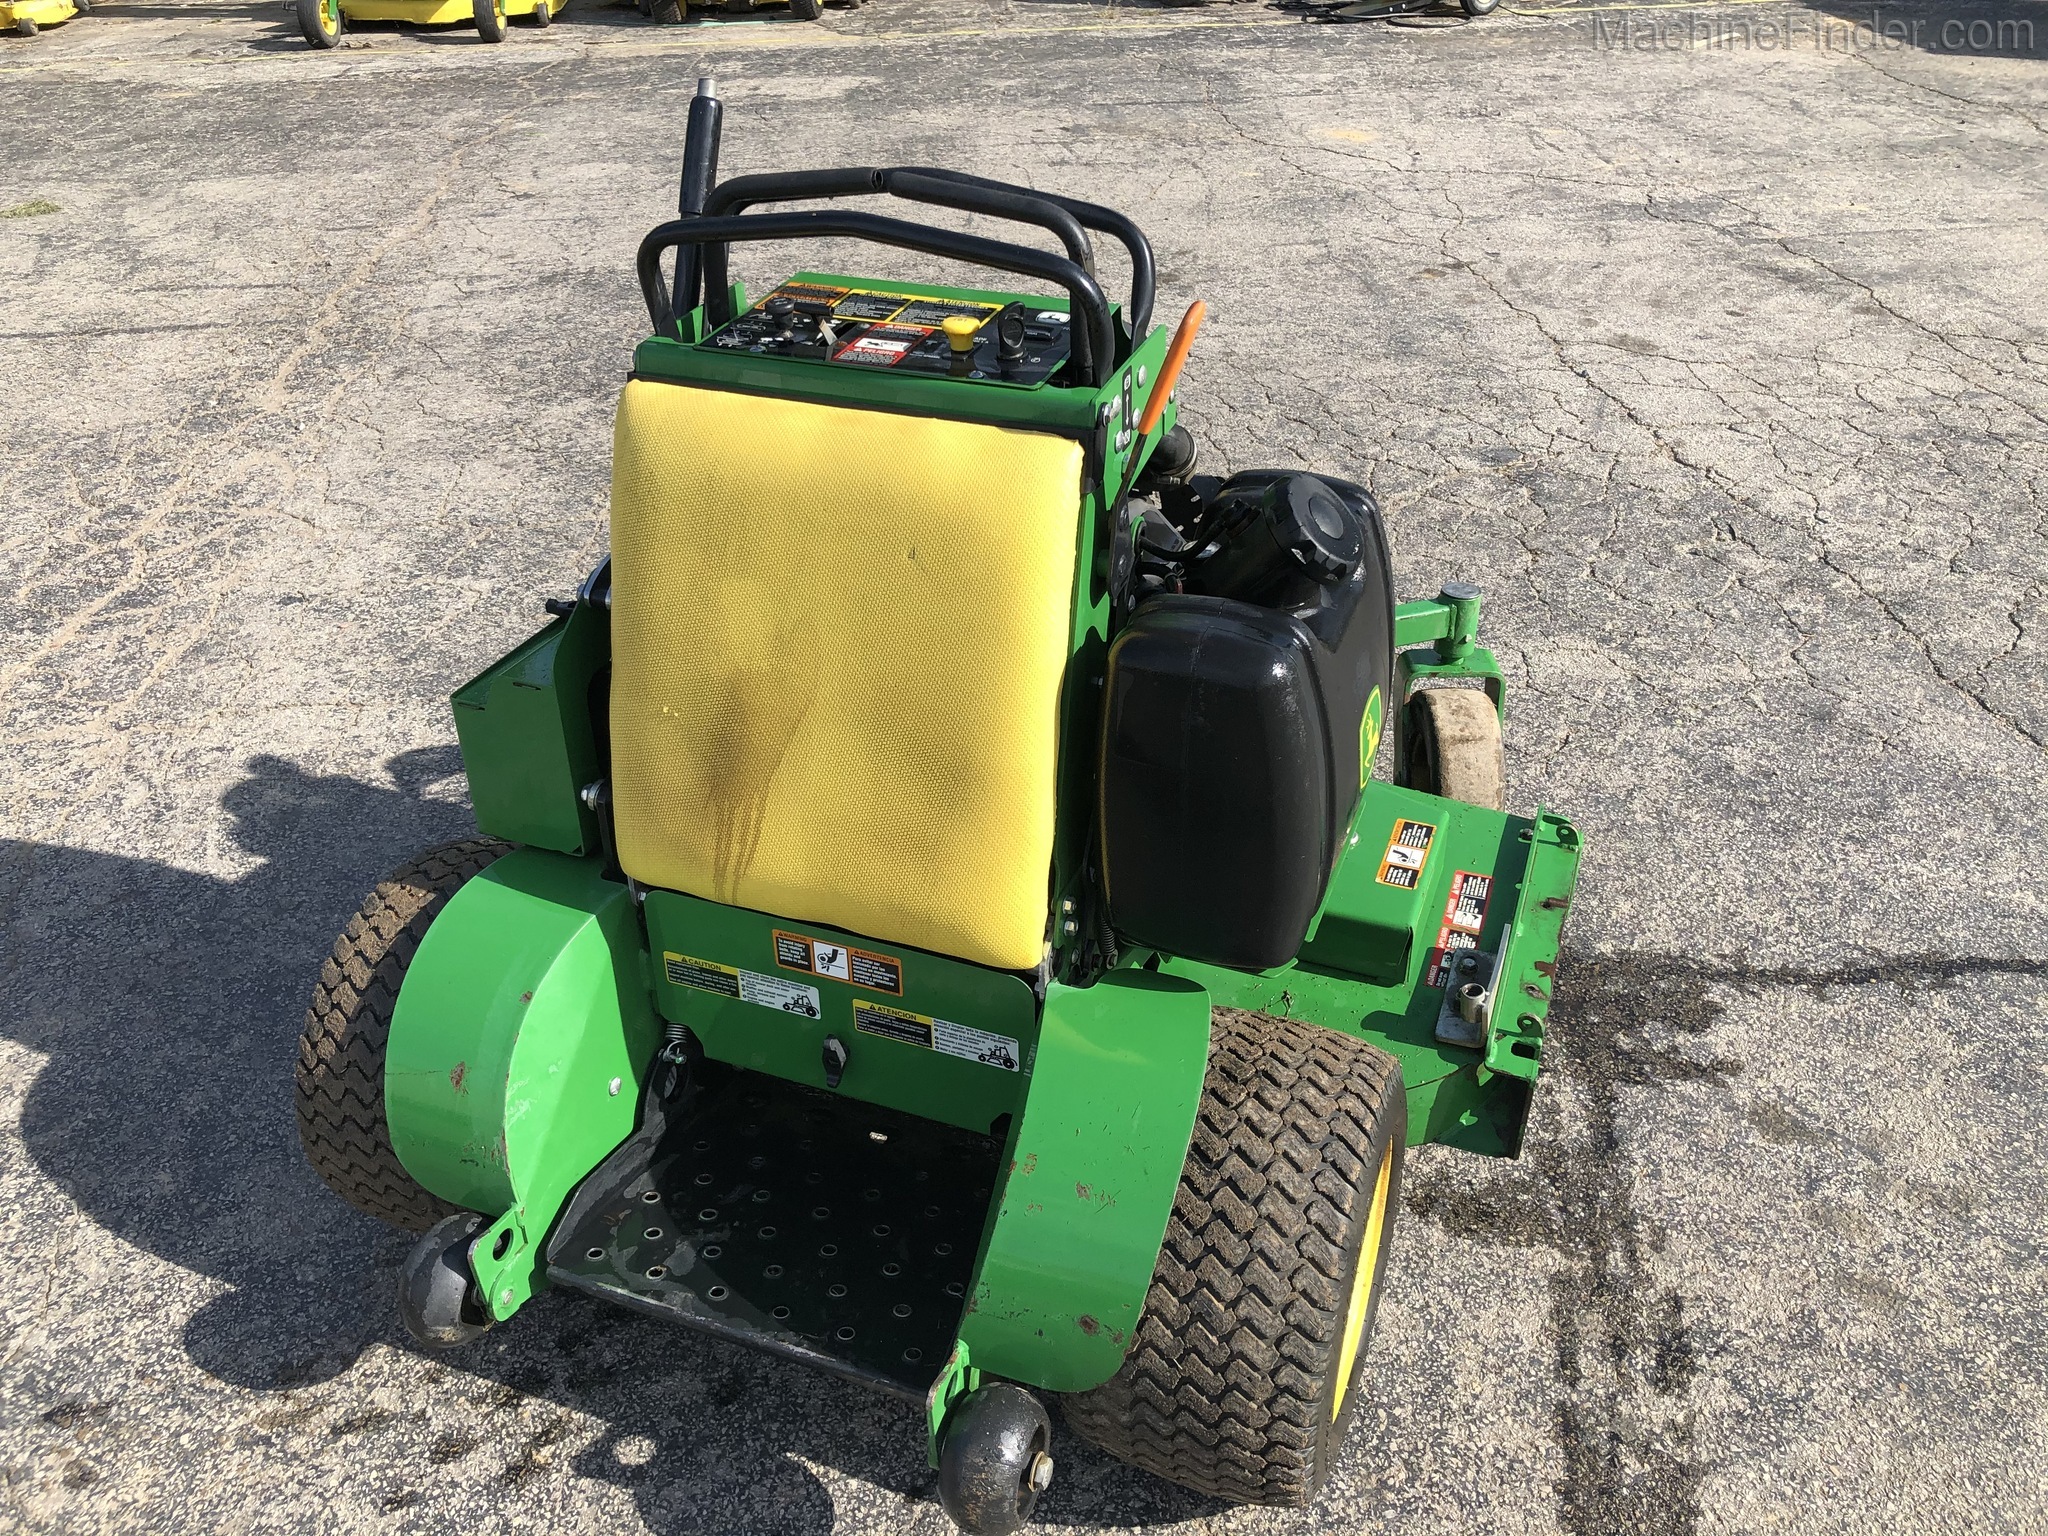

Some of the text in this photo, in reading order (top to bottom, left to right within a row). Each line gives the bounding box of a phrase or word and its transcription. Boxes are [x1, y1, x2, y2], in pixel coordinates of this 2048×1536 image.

[894, 324, 922, 332] DANGER
[863, 348, 896, 356] PELIGRO
[860, 950, 895, 963] ADVERTENCIA
[688, 958, 722, 971] CAUTION
[877, 1006, 917, 1021] ATENCION
